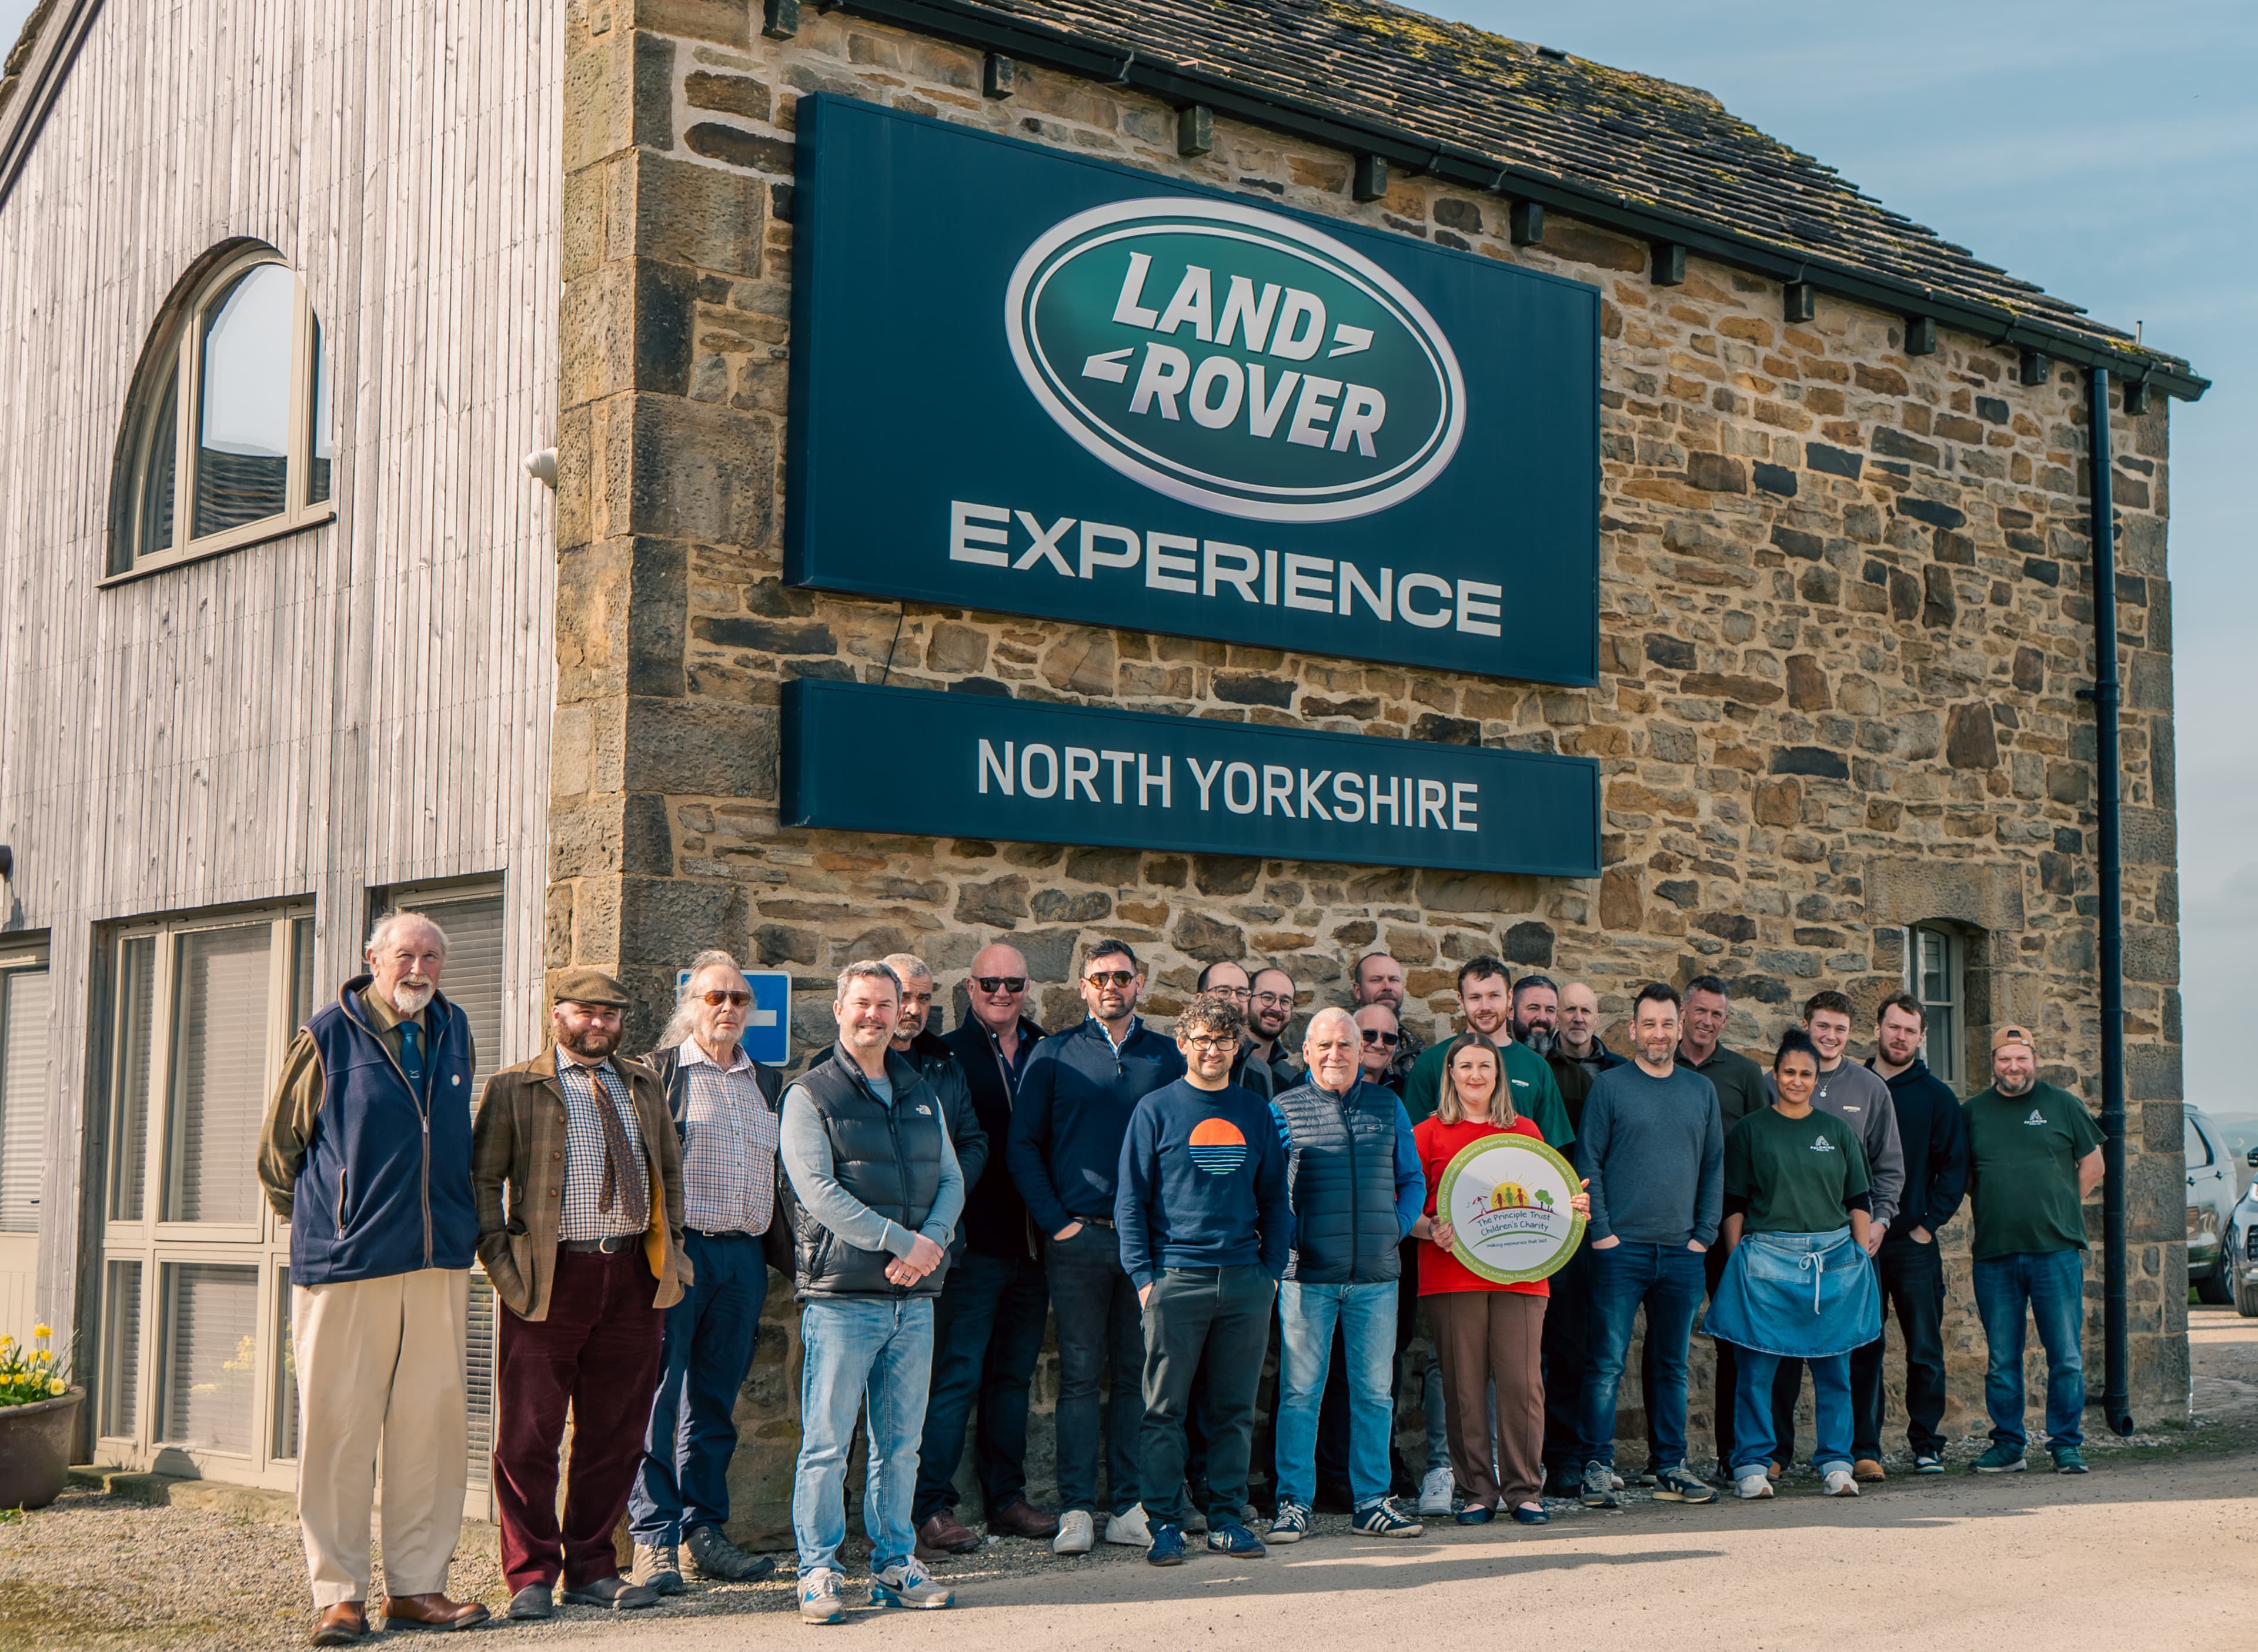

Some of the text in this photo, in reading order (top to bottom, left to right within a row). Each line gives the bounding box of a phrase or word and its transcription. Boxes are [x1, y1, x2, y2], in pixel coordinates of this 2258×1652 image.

[1113, 252, 1327, 362] LAND
[1129, 342, 1387, 459] ROVER
[949, 500, 1503, 637] EXPERIENCE
[978, 738, 1479, 832] NORTH YORKSHIRE
[1477, 1210, 1551, 1227] The Principle Trust
[1481, 1220, 1548, 1236] Children's Charity
